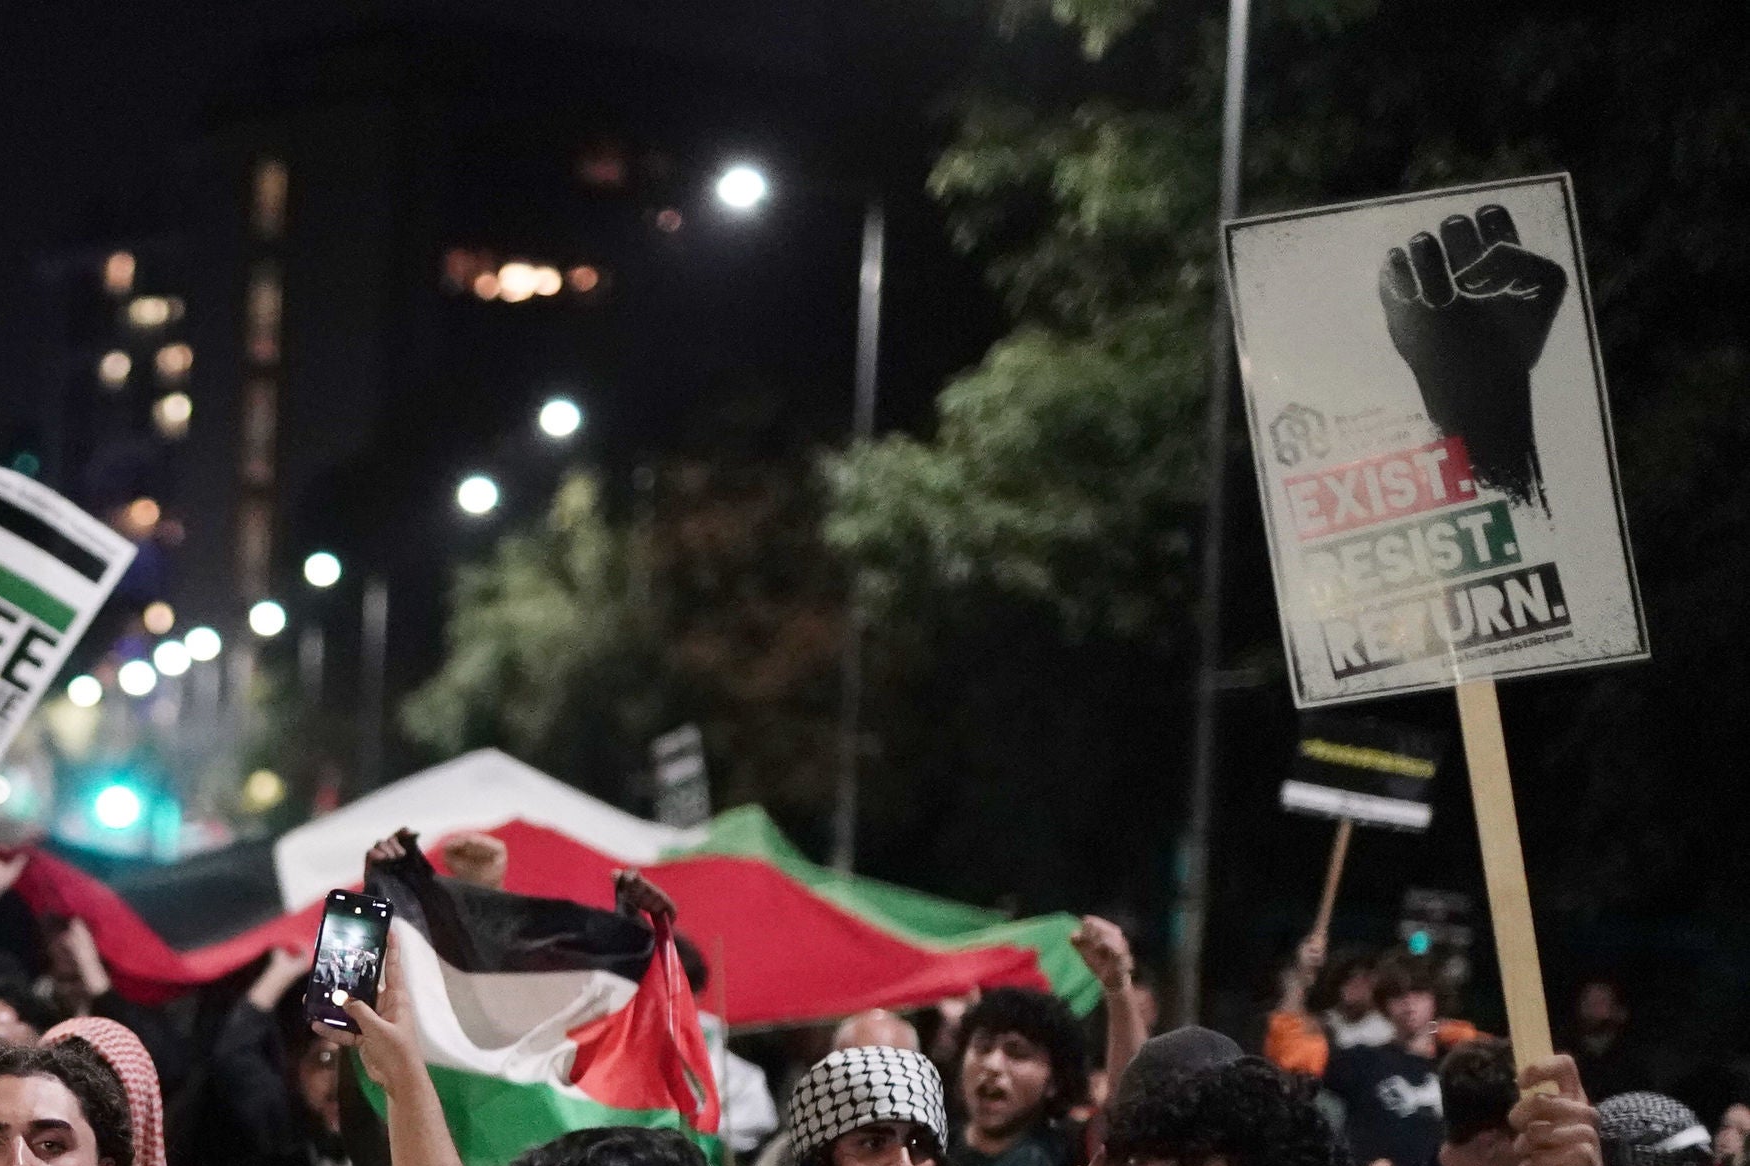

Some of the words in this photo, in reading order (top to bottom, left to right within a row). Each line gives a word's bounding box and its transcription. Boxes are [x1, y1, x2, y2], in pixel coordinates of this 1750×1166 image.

[1287, 447, 1473, 529] EXIST.
[1300, 511, 1519, 600] RESIST.
[1324, 572, 1567, 671] RETURN.
